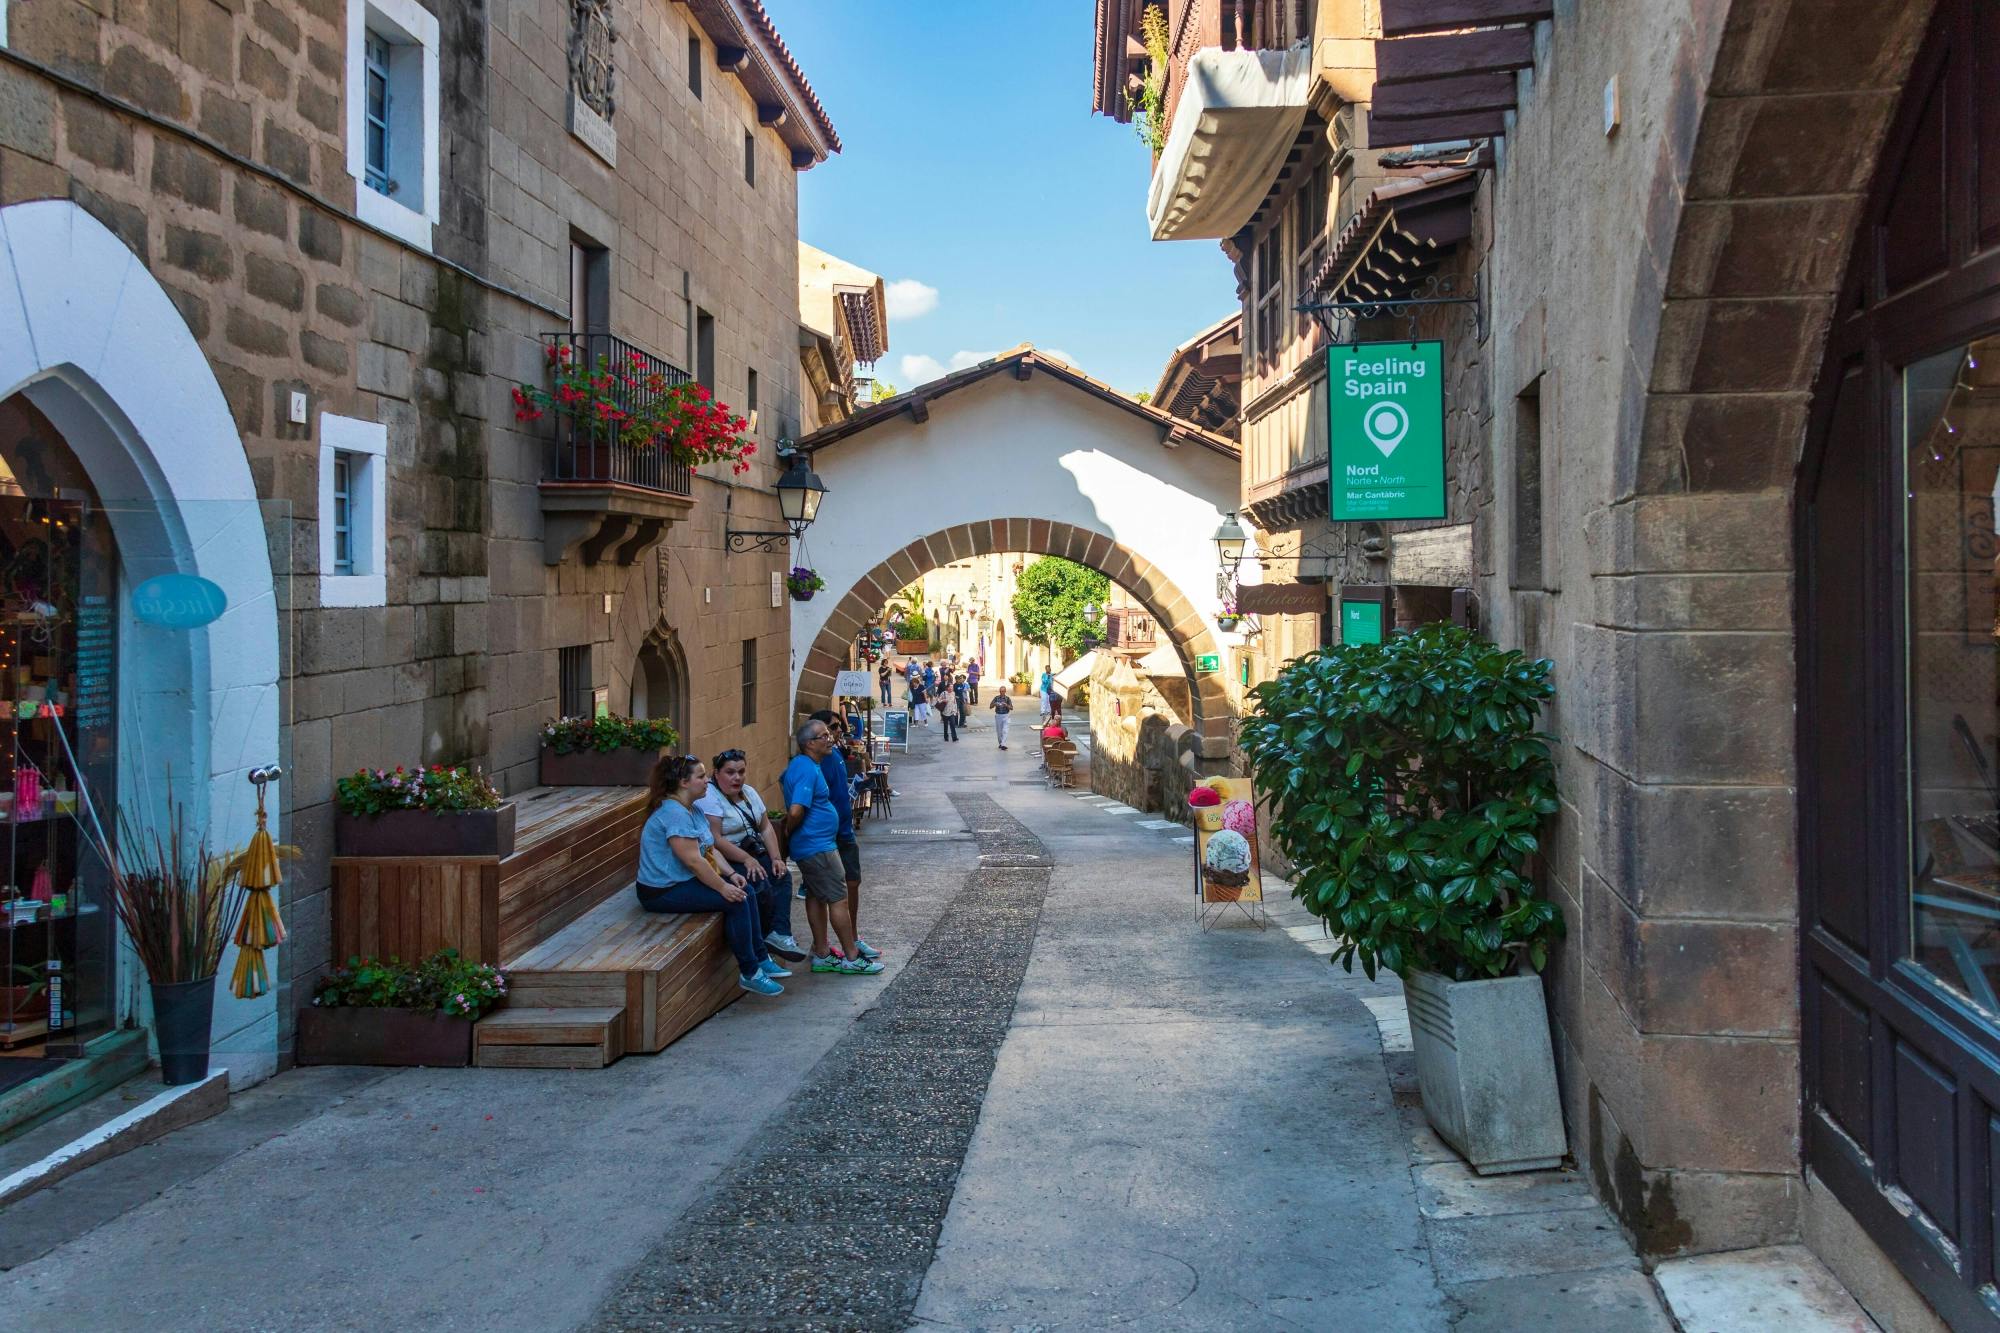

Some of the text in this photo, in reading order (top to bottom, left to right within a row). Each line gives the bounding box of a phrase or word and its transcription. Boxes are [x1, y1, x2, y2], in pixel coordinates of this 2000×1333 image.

[1345, 358, 1425, 377] Feeling
[1345, 378, 1407, 399] Spain
[1346, 464, 1379, 476] Nord
[1346, 476, 1406, 485] Norte North
